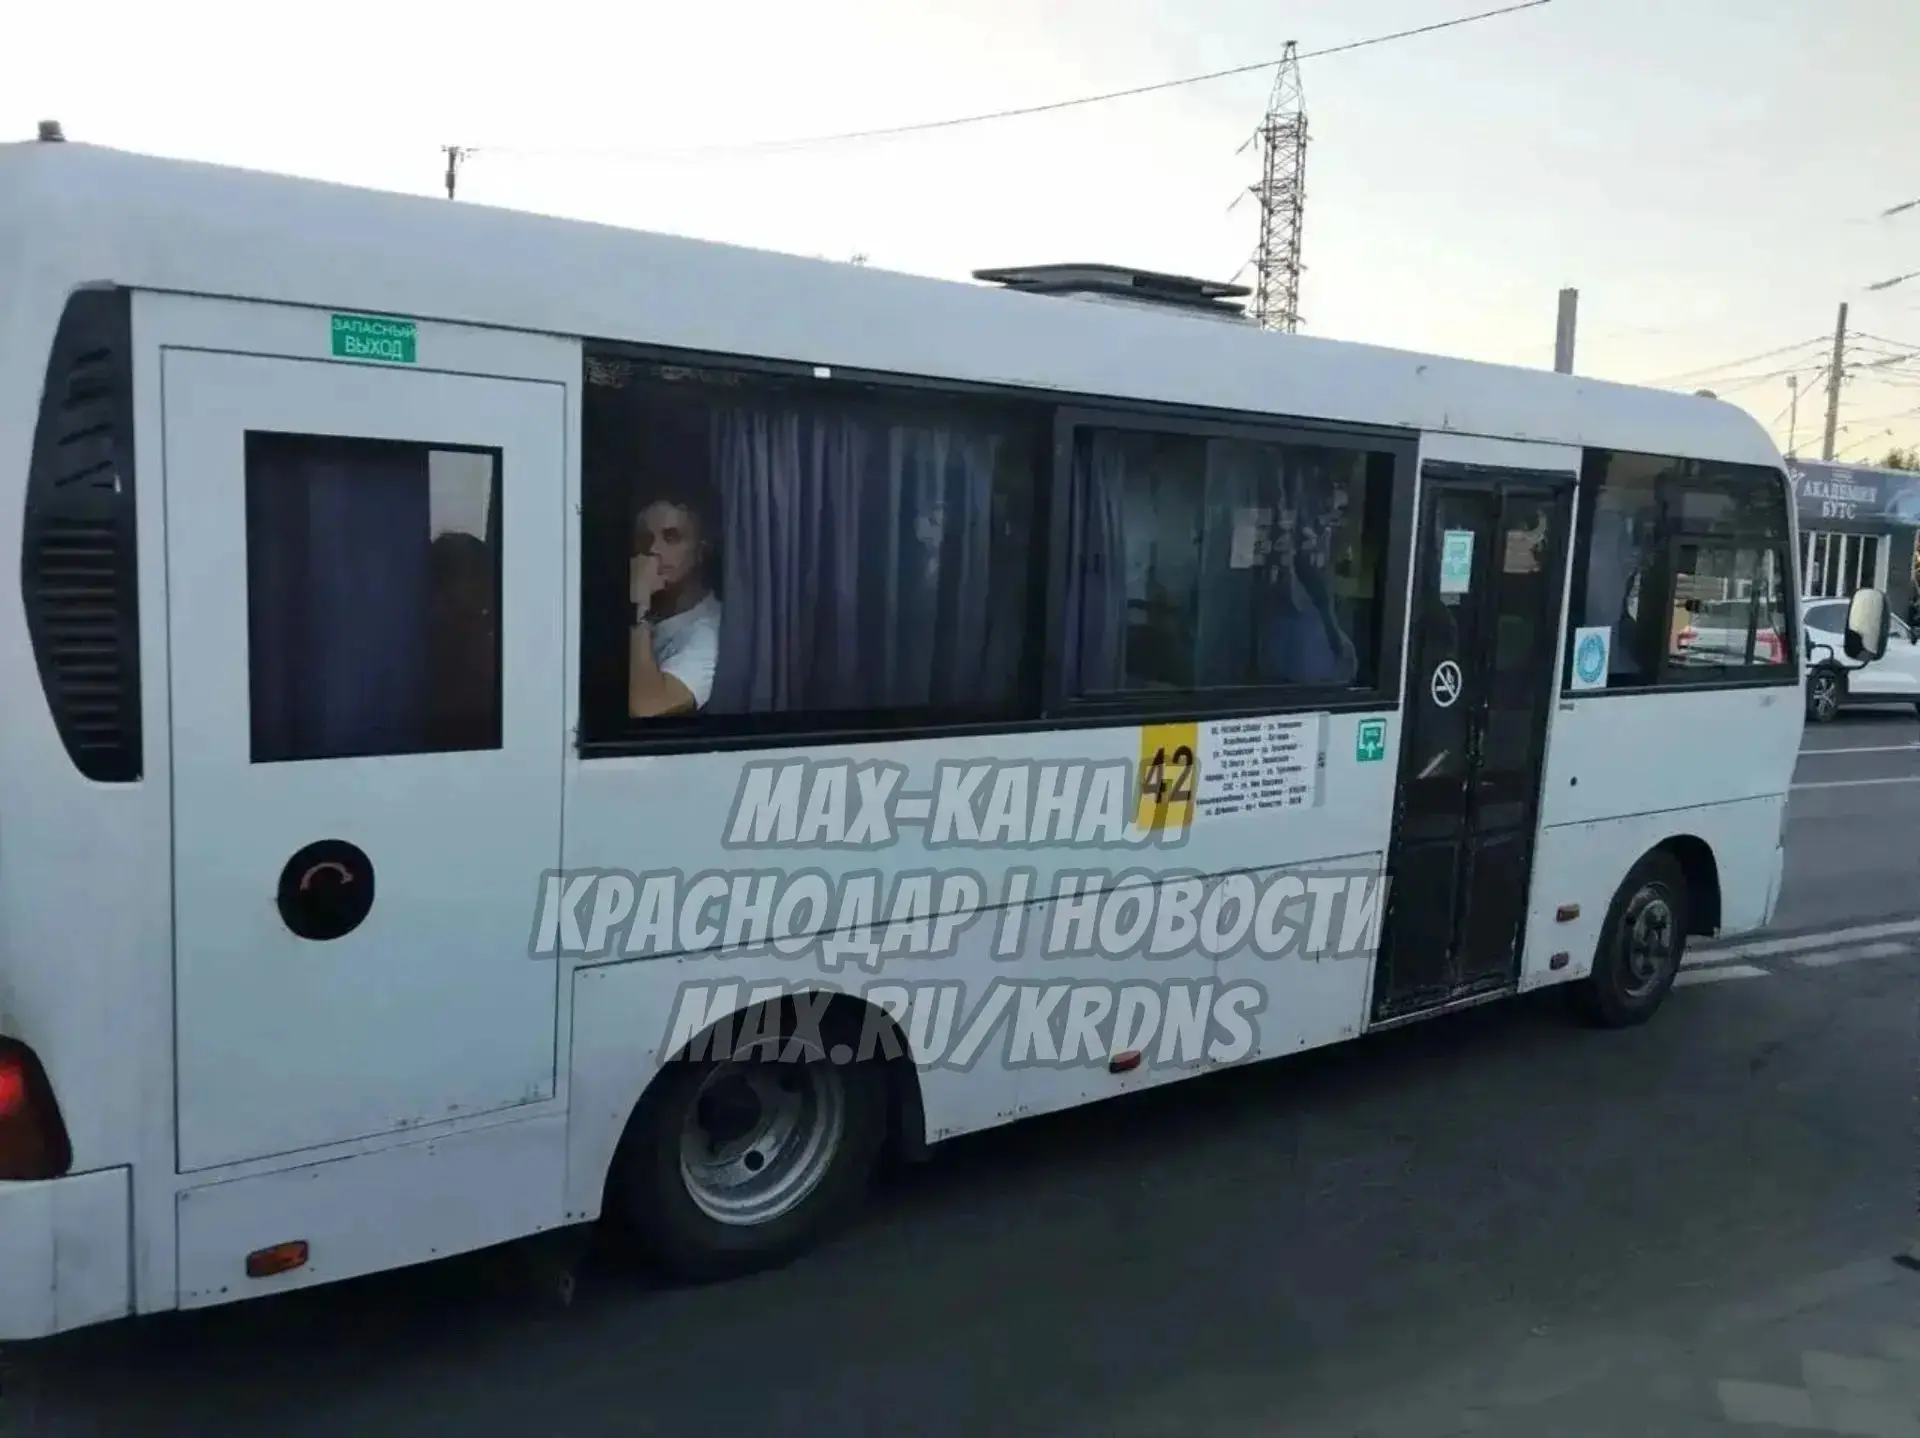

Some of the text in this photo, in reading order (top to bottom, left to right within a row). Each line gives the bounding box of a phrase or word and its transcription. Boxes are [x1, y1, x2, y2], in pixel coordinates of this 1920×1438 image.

[345, 334, 404, 360] ВЫХОД
[1803, 481, 1878, 503] АКАДЕМИЯ
[1822, 501, 1857, 520] БУТС
[1141, 744, 1193, 803] 42
